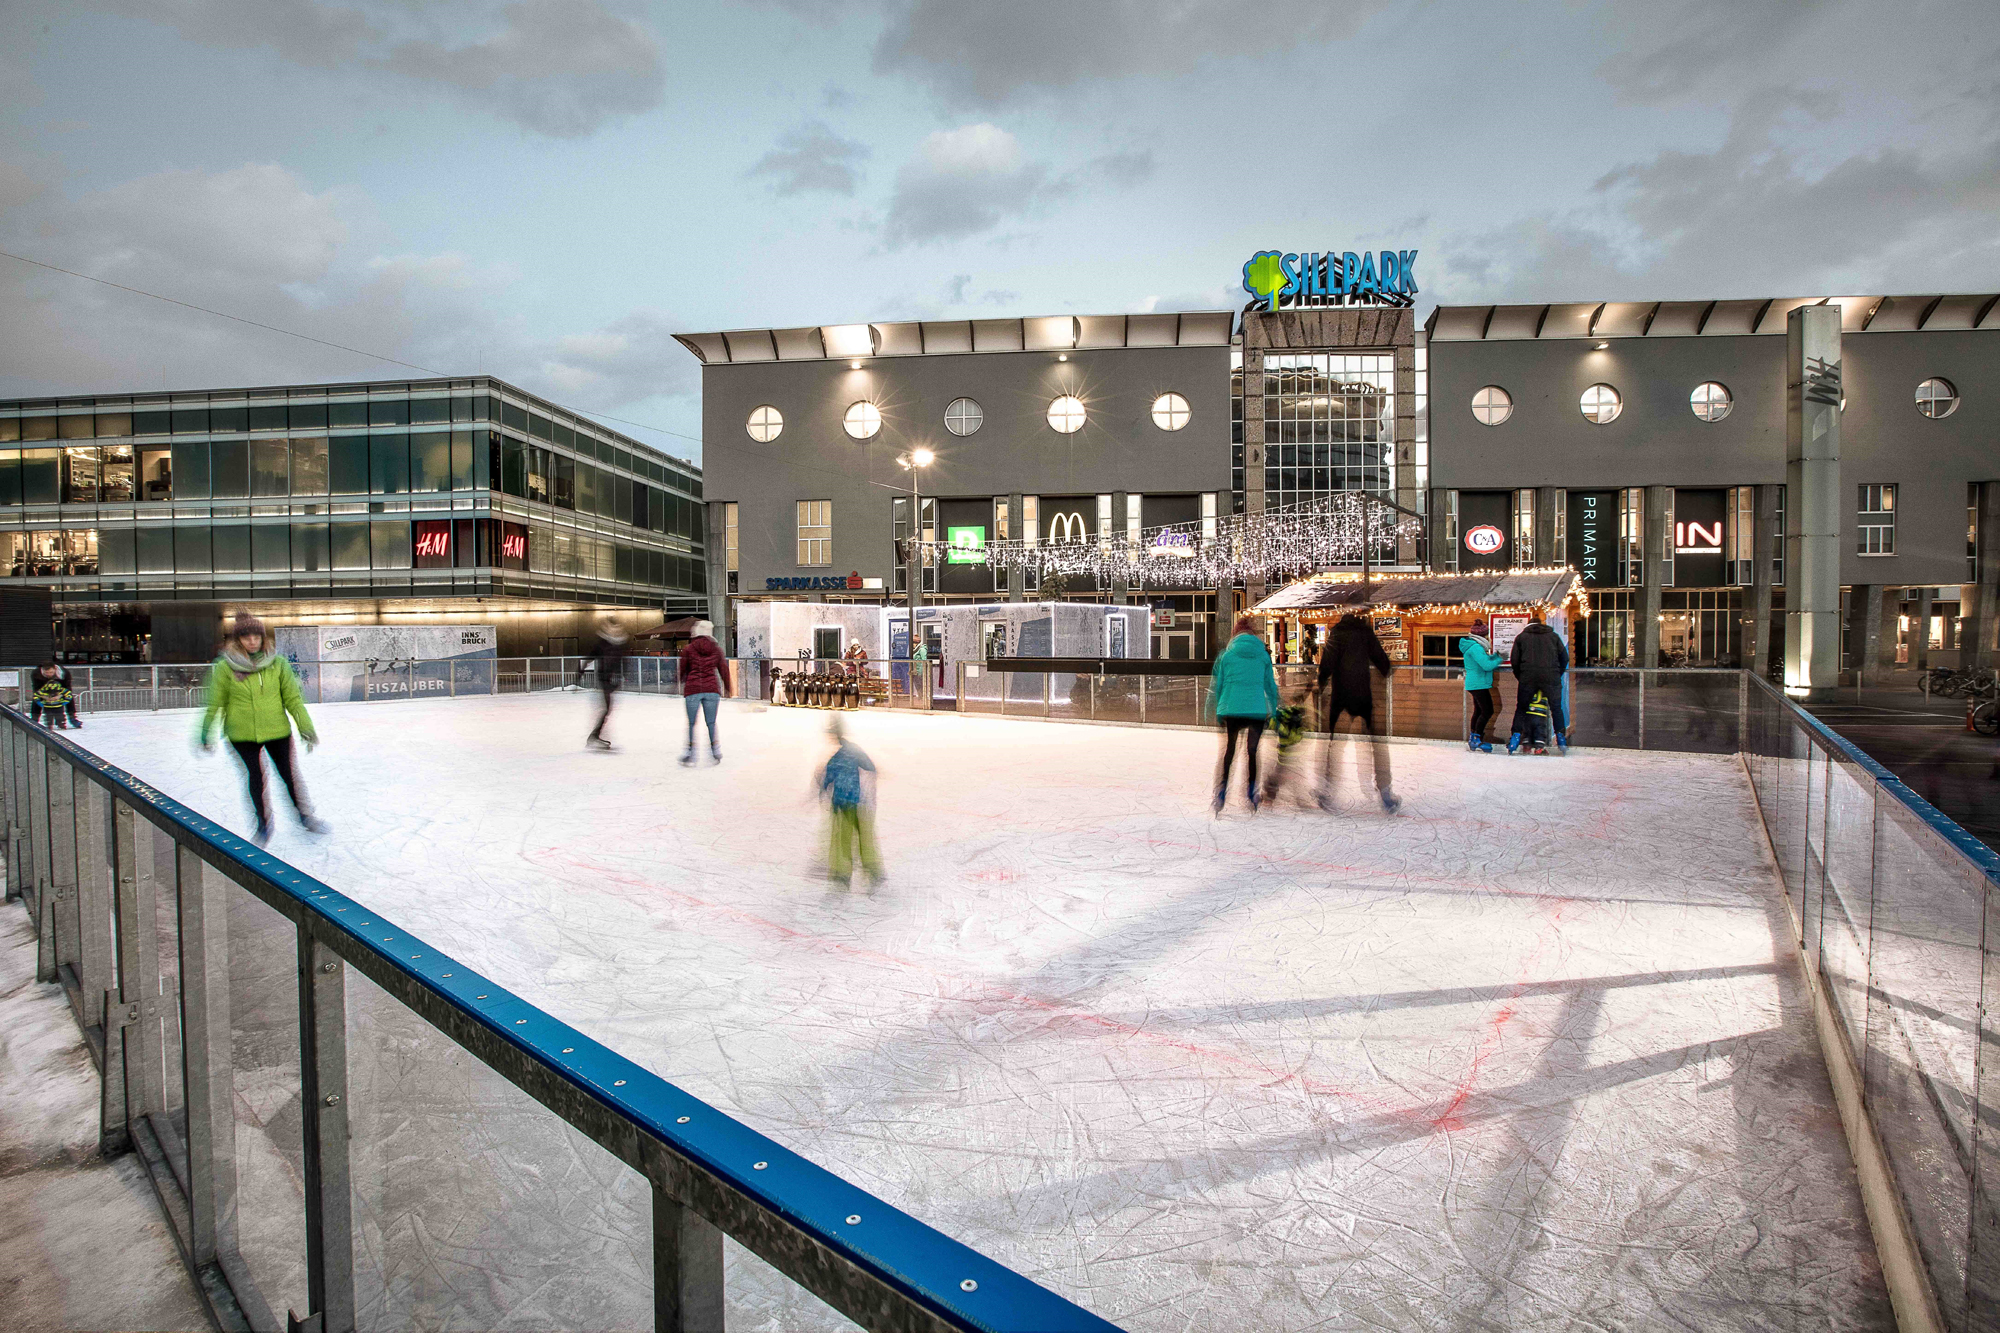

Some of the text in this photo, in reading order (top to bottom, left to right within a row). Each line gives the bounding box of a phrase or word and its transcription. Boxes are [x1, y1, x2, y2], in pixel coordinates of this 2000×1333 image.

[1281, 250, 1419, 296] SILLPARK
[1156, 528, 1187, 547] dm
[1473, 533, 1497, 546] C&A
[1583, 497, 1596, 581] PRIMARK
[1675, 521, 1722, 547] IN
[416, 532, 448, 557] H&M
[503, 534, 525, 560] H&M
[765, 576, 847, 590] SPARKASSE
[330, 635, 355, 648] SILLPARK
[1382, 643, 1408, 652] OFFEE
[368, 679, 445, 694] EISZAUBER
